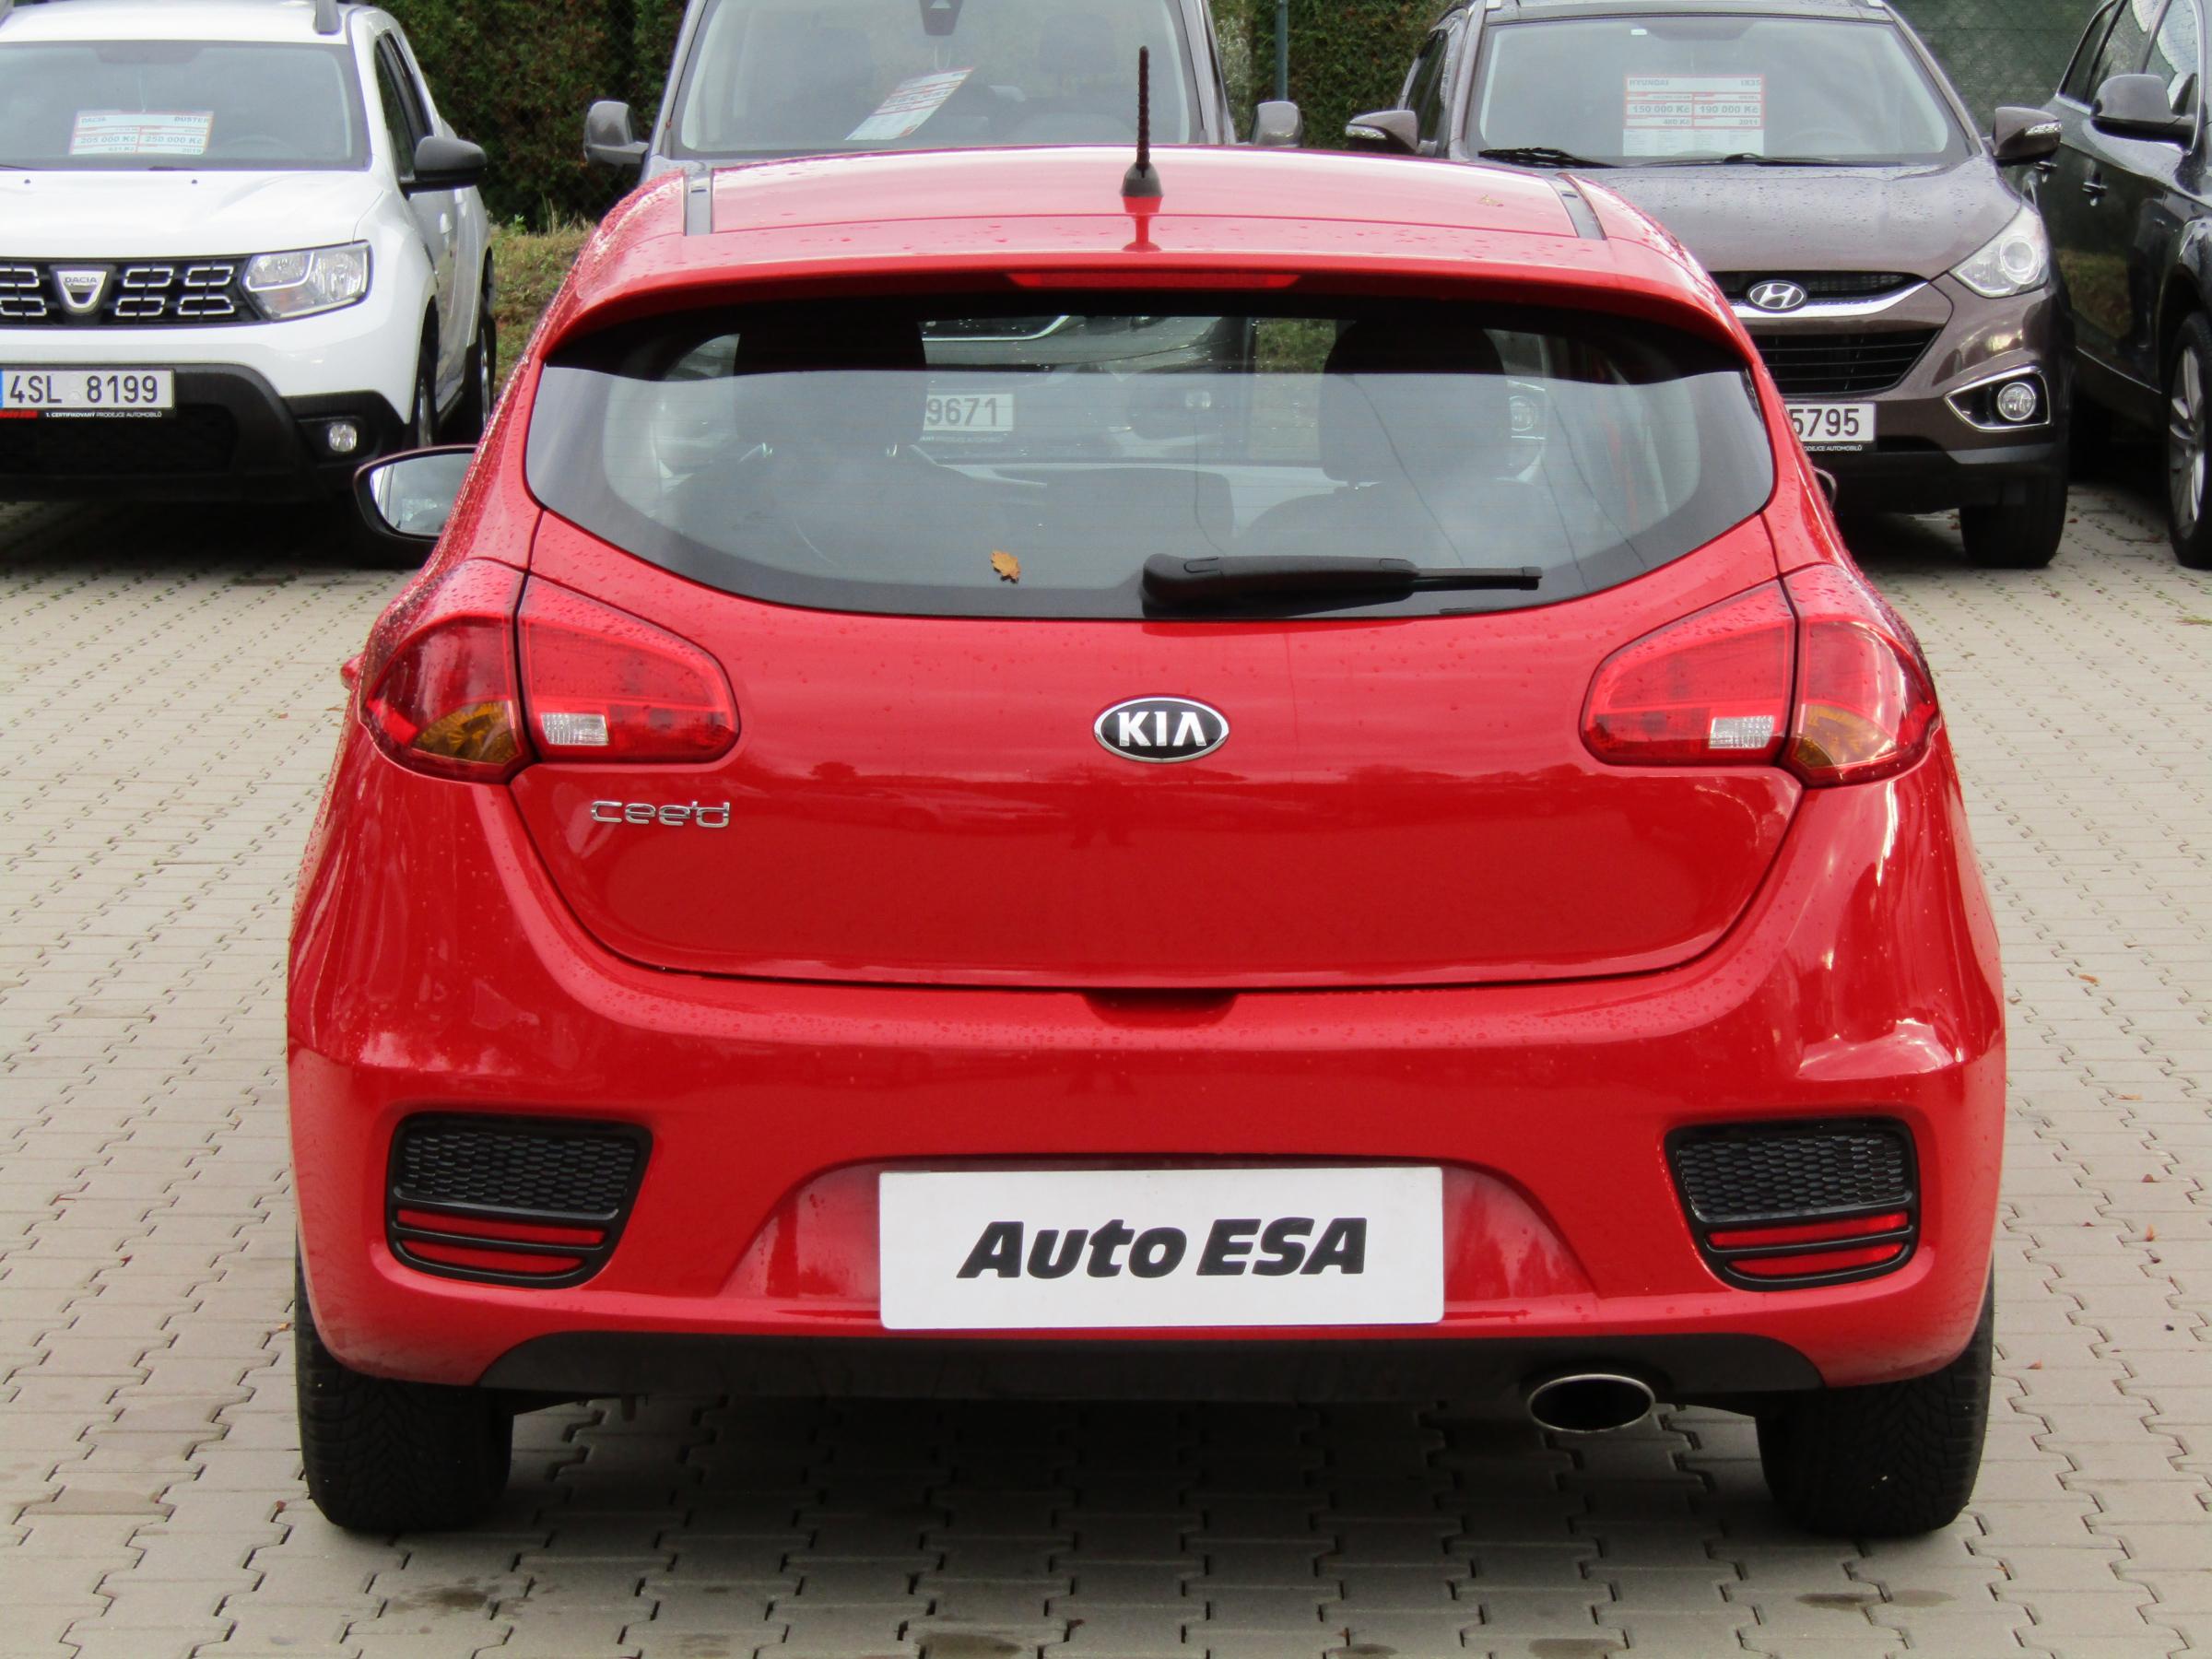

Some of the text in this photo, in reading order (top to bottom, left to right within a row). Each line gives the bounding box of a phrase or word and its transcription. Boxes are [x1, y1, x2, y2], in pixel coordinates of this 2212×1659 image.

[1633, 105, 1652, 113] 150
[1653, 105, 1674, 113] 000
[1700, 105, 1718, 113] 190
[1721, 105, 1741, 113] 000
[9, 375, 158, 404] 4SL 8199
[926, 397, 997, 427] 9671
[1789, 407, 1860, 437] 5795
[1117, 711, 1207, 747] KIA
[955, 1216, 1368, 1280] Auto ESA
